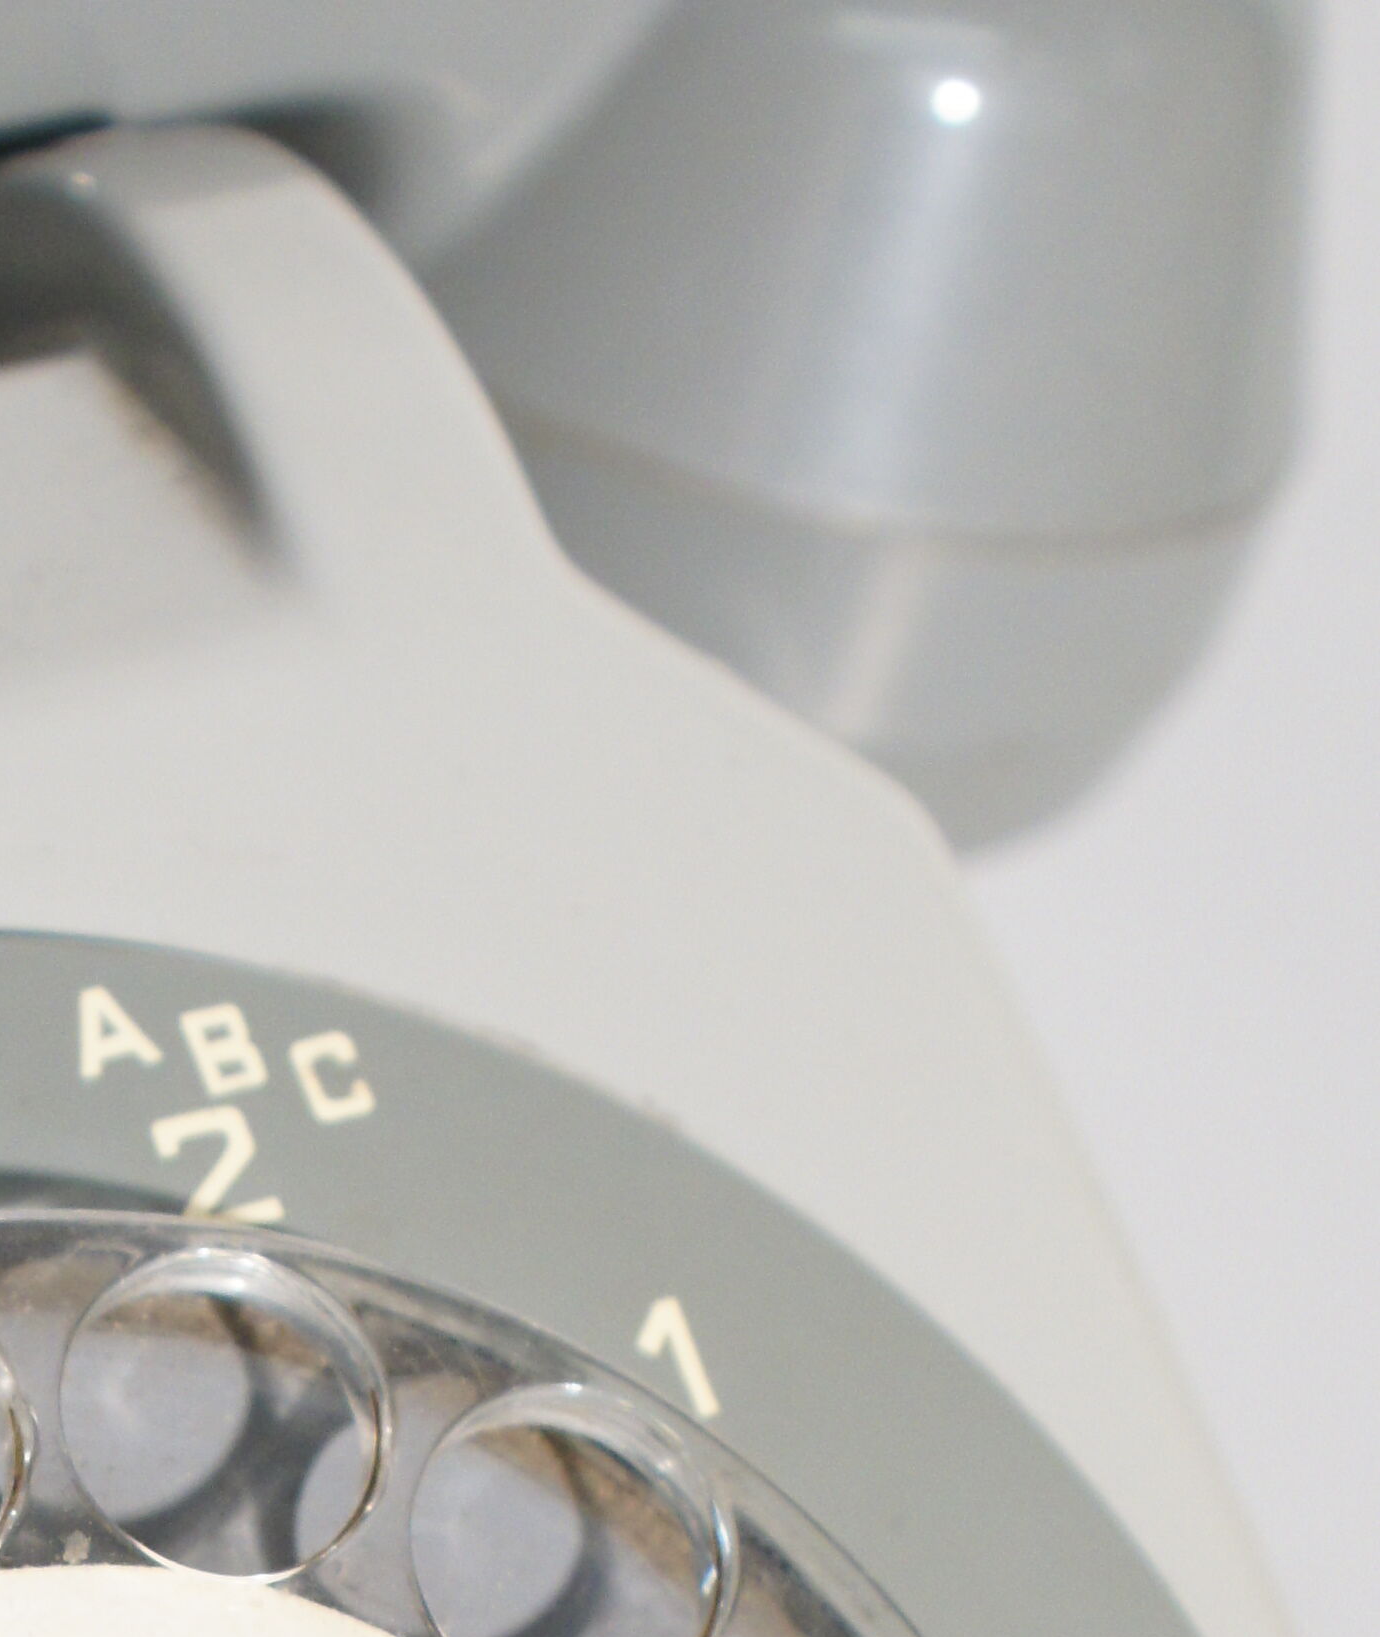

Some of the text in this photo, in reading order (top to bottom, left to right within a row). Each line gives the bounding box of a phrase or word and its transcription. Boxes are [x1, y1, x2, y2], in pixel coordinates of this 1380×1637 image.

[76, 985, 376, 1125] ABC
[152, 1106, 285, 1225] 2
[636, 1296, 720, 1417] 1
